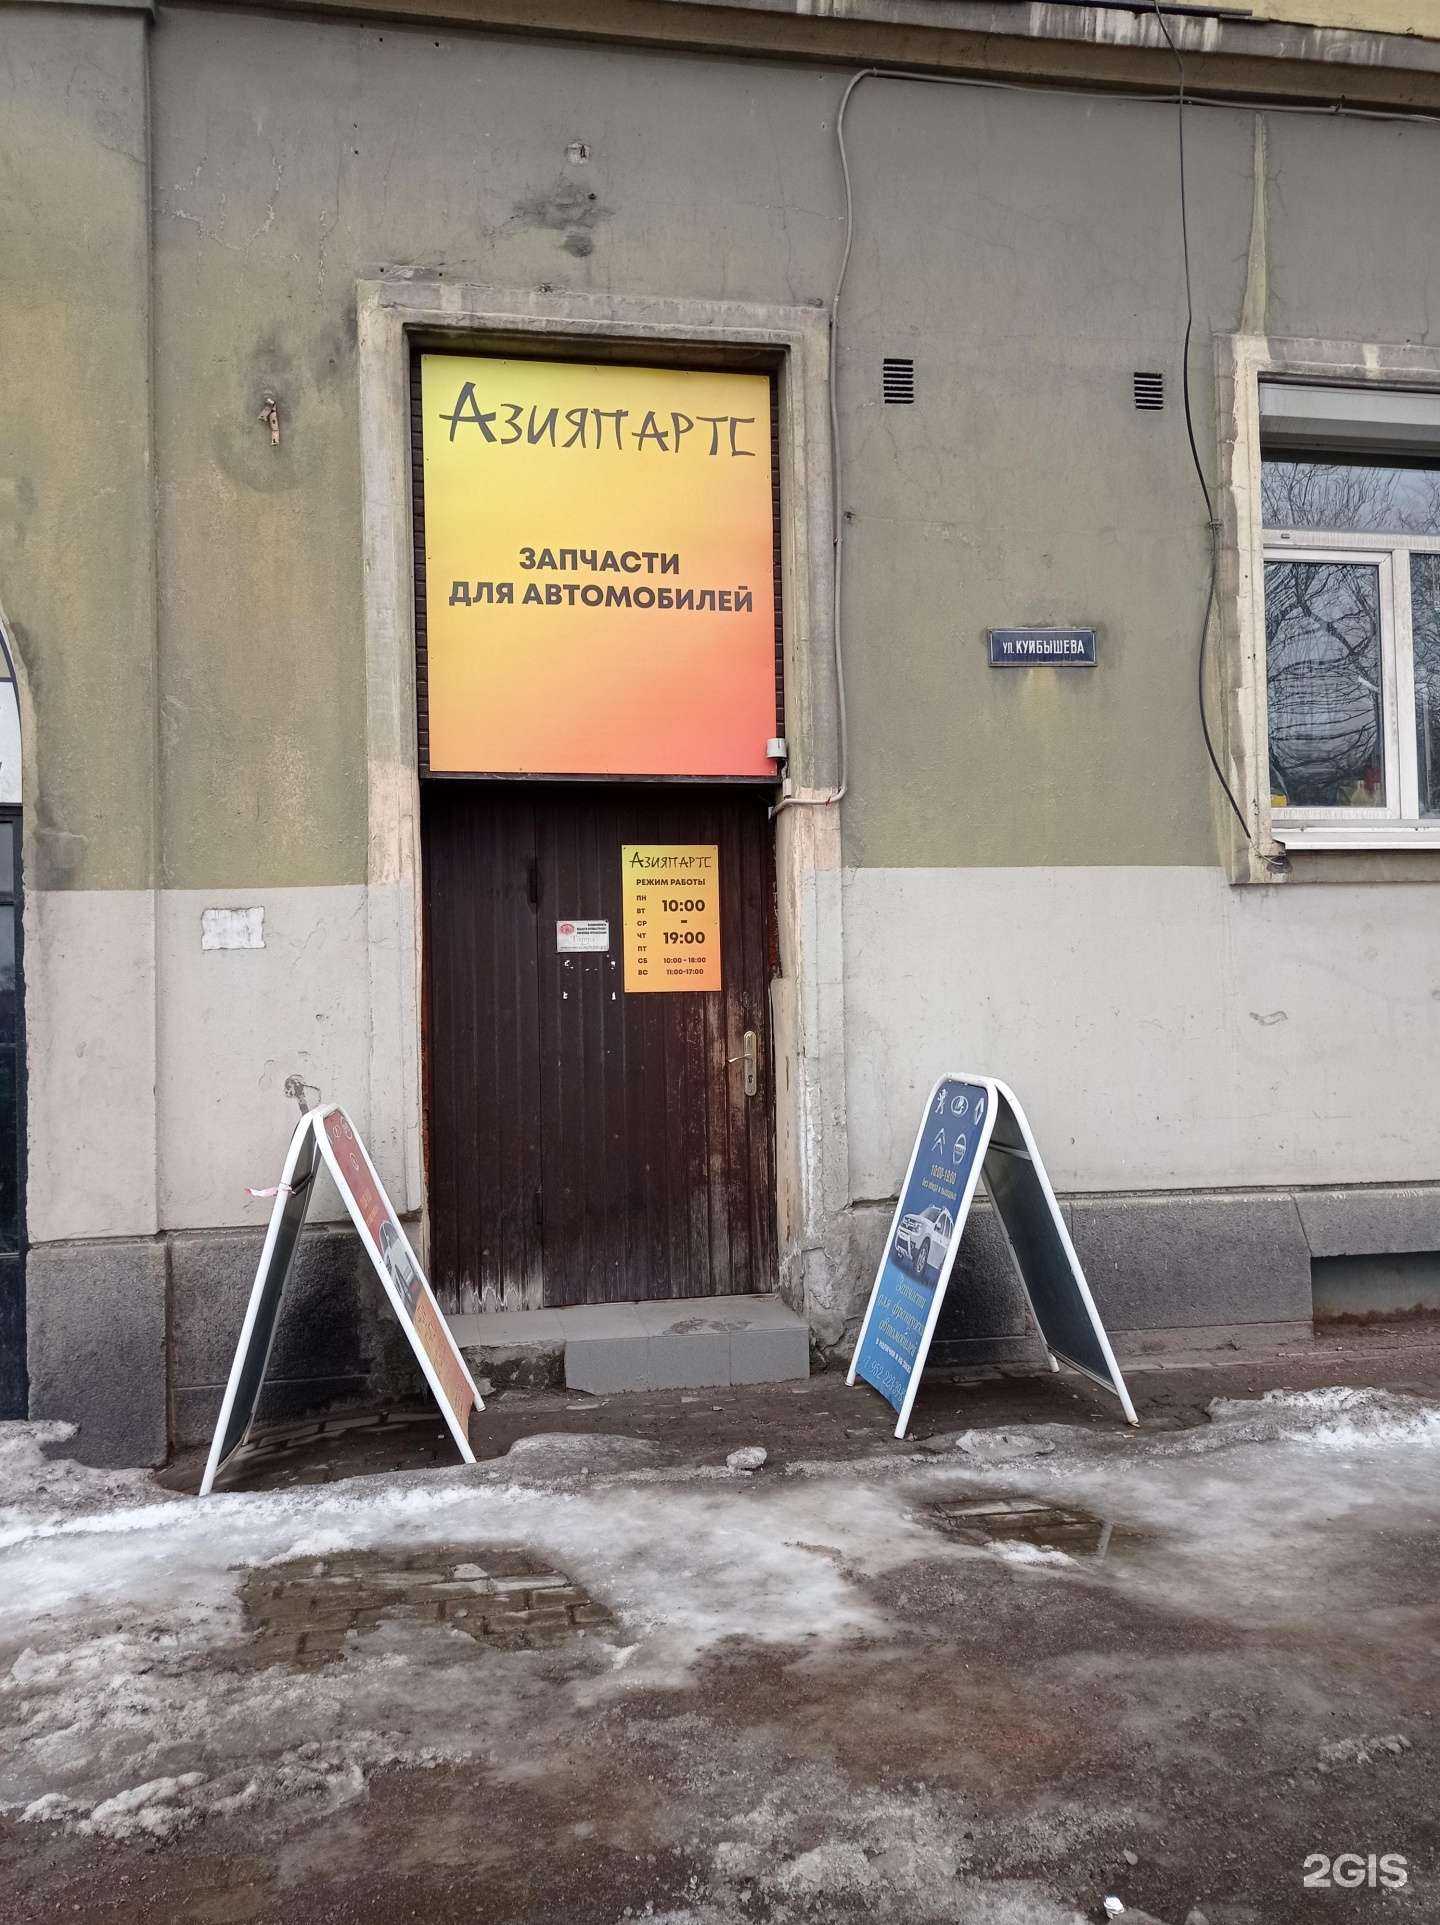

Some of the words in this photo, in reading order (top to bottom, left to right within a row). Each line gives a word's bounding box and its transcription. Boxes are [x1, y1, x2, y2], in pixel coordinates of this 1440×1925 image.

[519, 547, 680, 575] ЗАПЧАСТИ
[449, 580, 514, 607] ДЛЯ
[521, 583, 754, 613] АВТОМОБИЛЕЙ
[1015, 639, 1085, 654] КУЙБЫШЕВА
[662, 900, 706, 912] 10:00
[663, 931, 706, 944] 19:00
